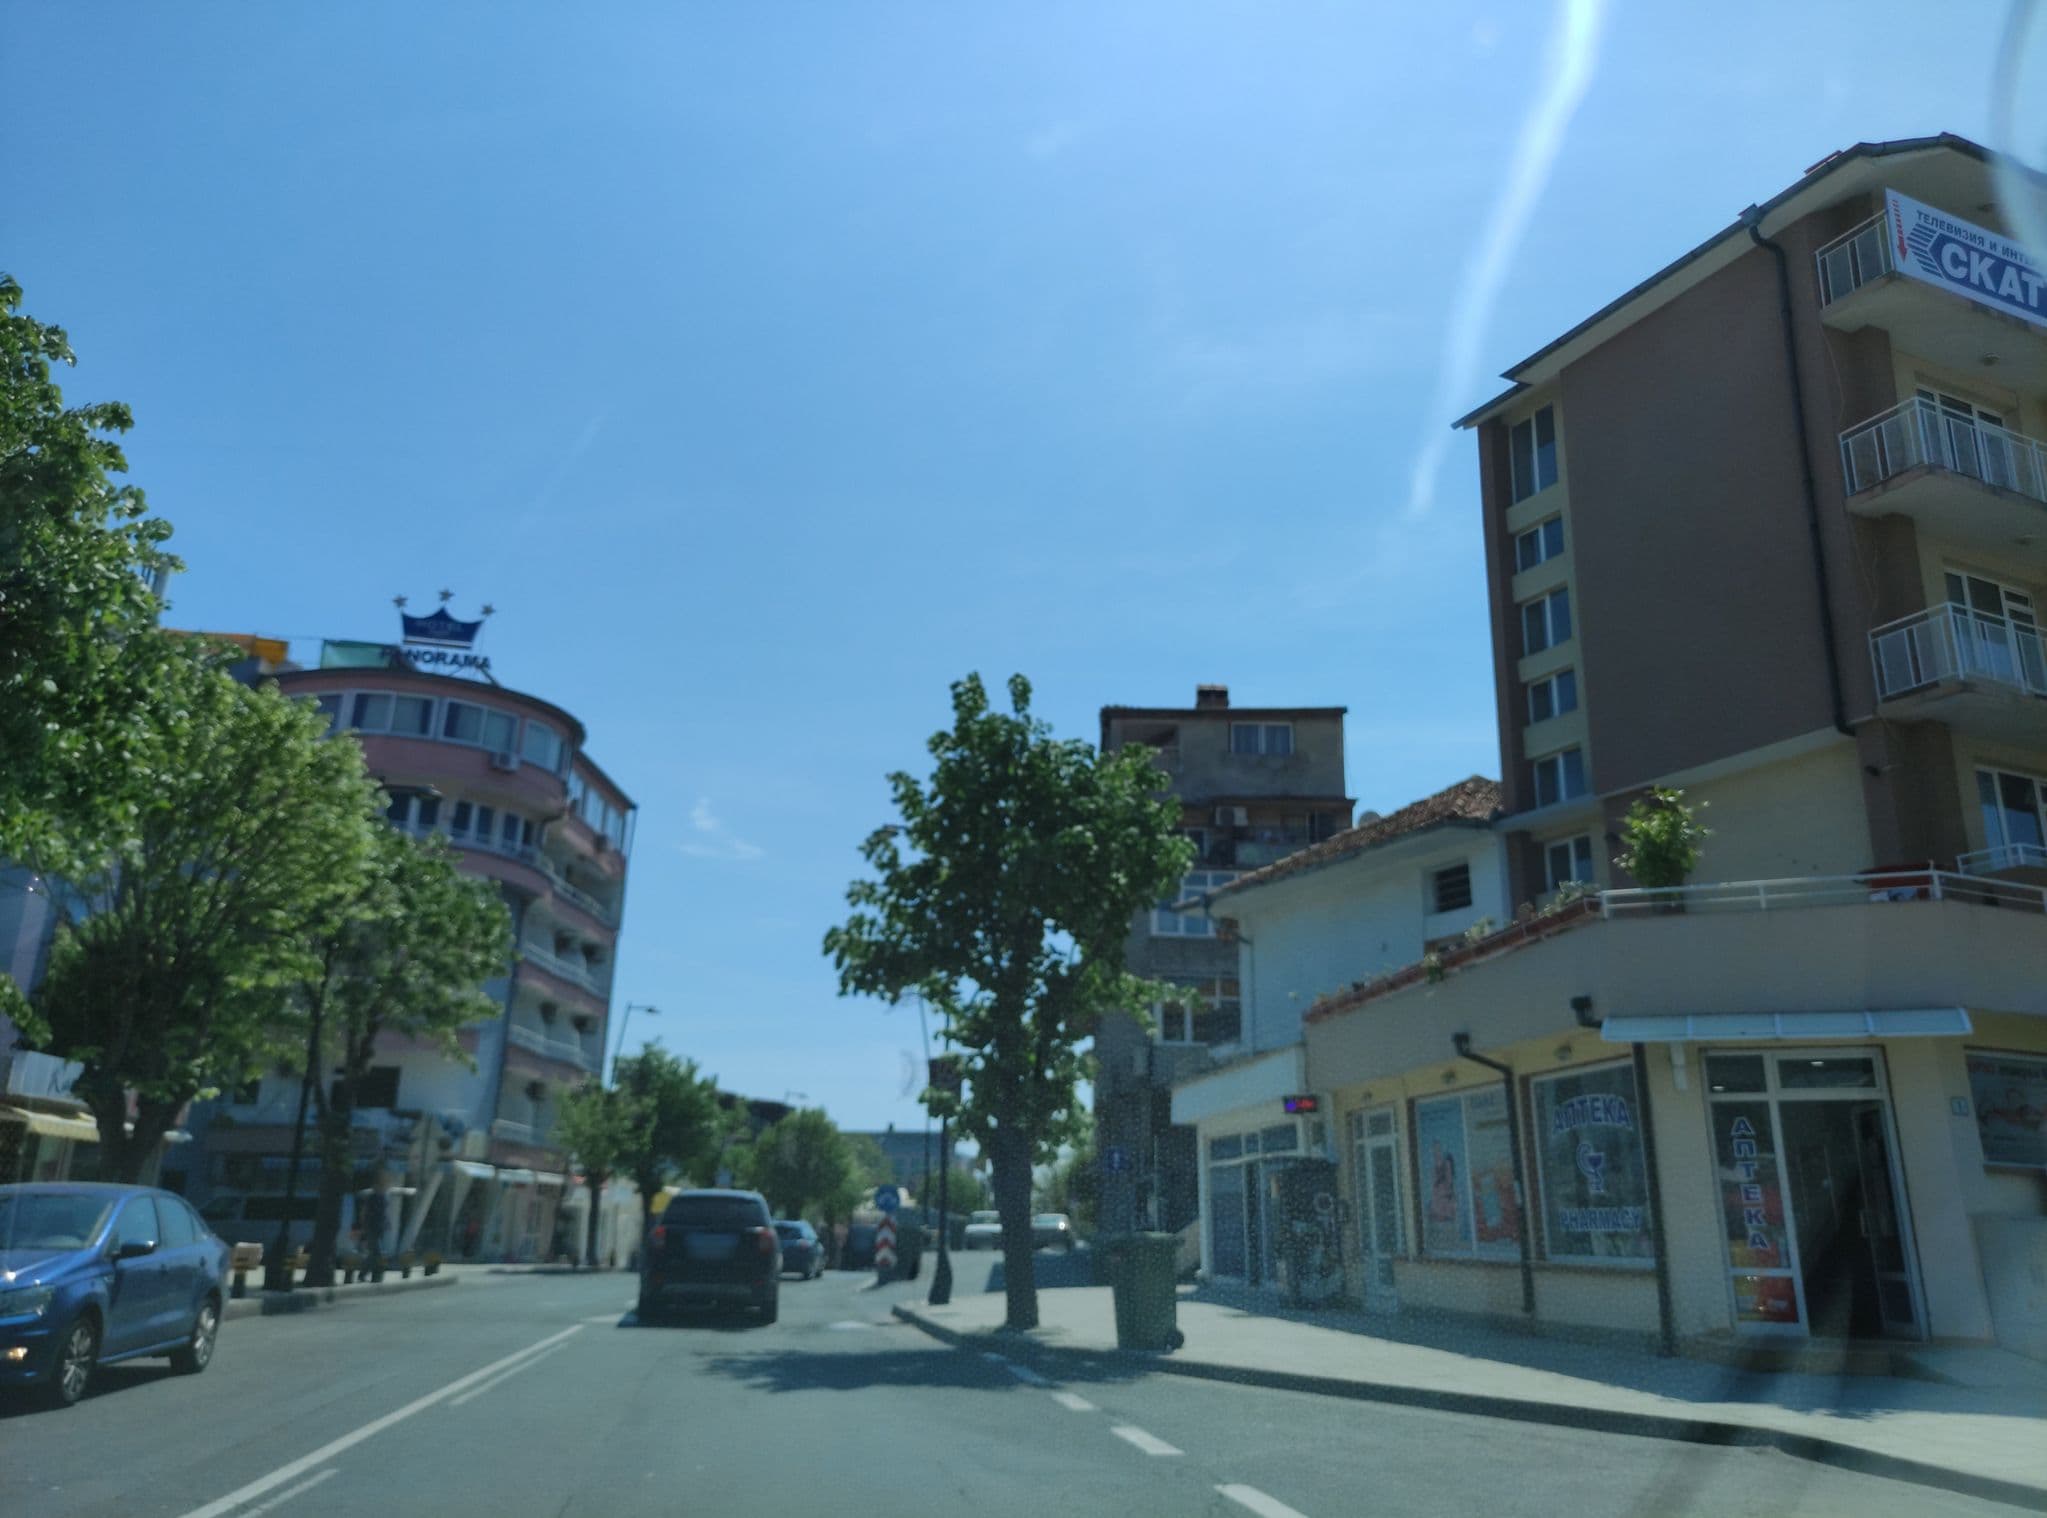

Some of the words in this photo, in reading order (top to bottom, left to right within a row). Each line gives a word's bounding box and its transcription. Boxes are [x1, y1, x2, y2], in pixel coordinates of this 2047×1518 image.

[1916, 210, 1985, 248] ТЕЛЕВИЗИЯ
[1989, 240, 1998, 253] И
[1940, 243, 2045, 307] СКАТ
[1552, 1094, 1633, 1133] АПТЕКА
[1731, 1116, 1768, 1249] АПТЕКА
[1560, 1207, 1642, 1232] PHARMACY
